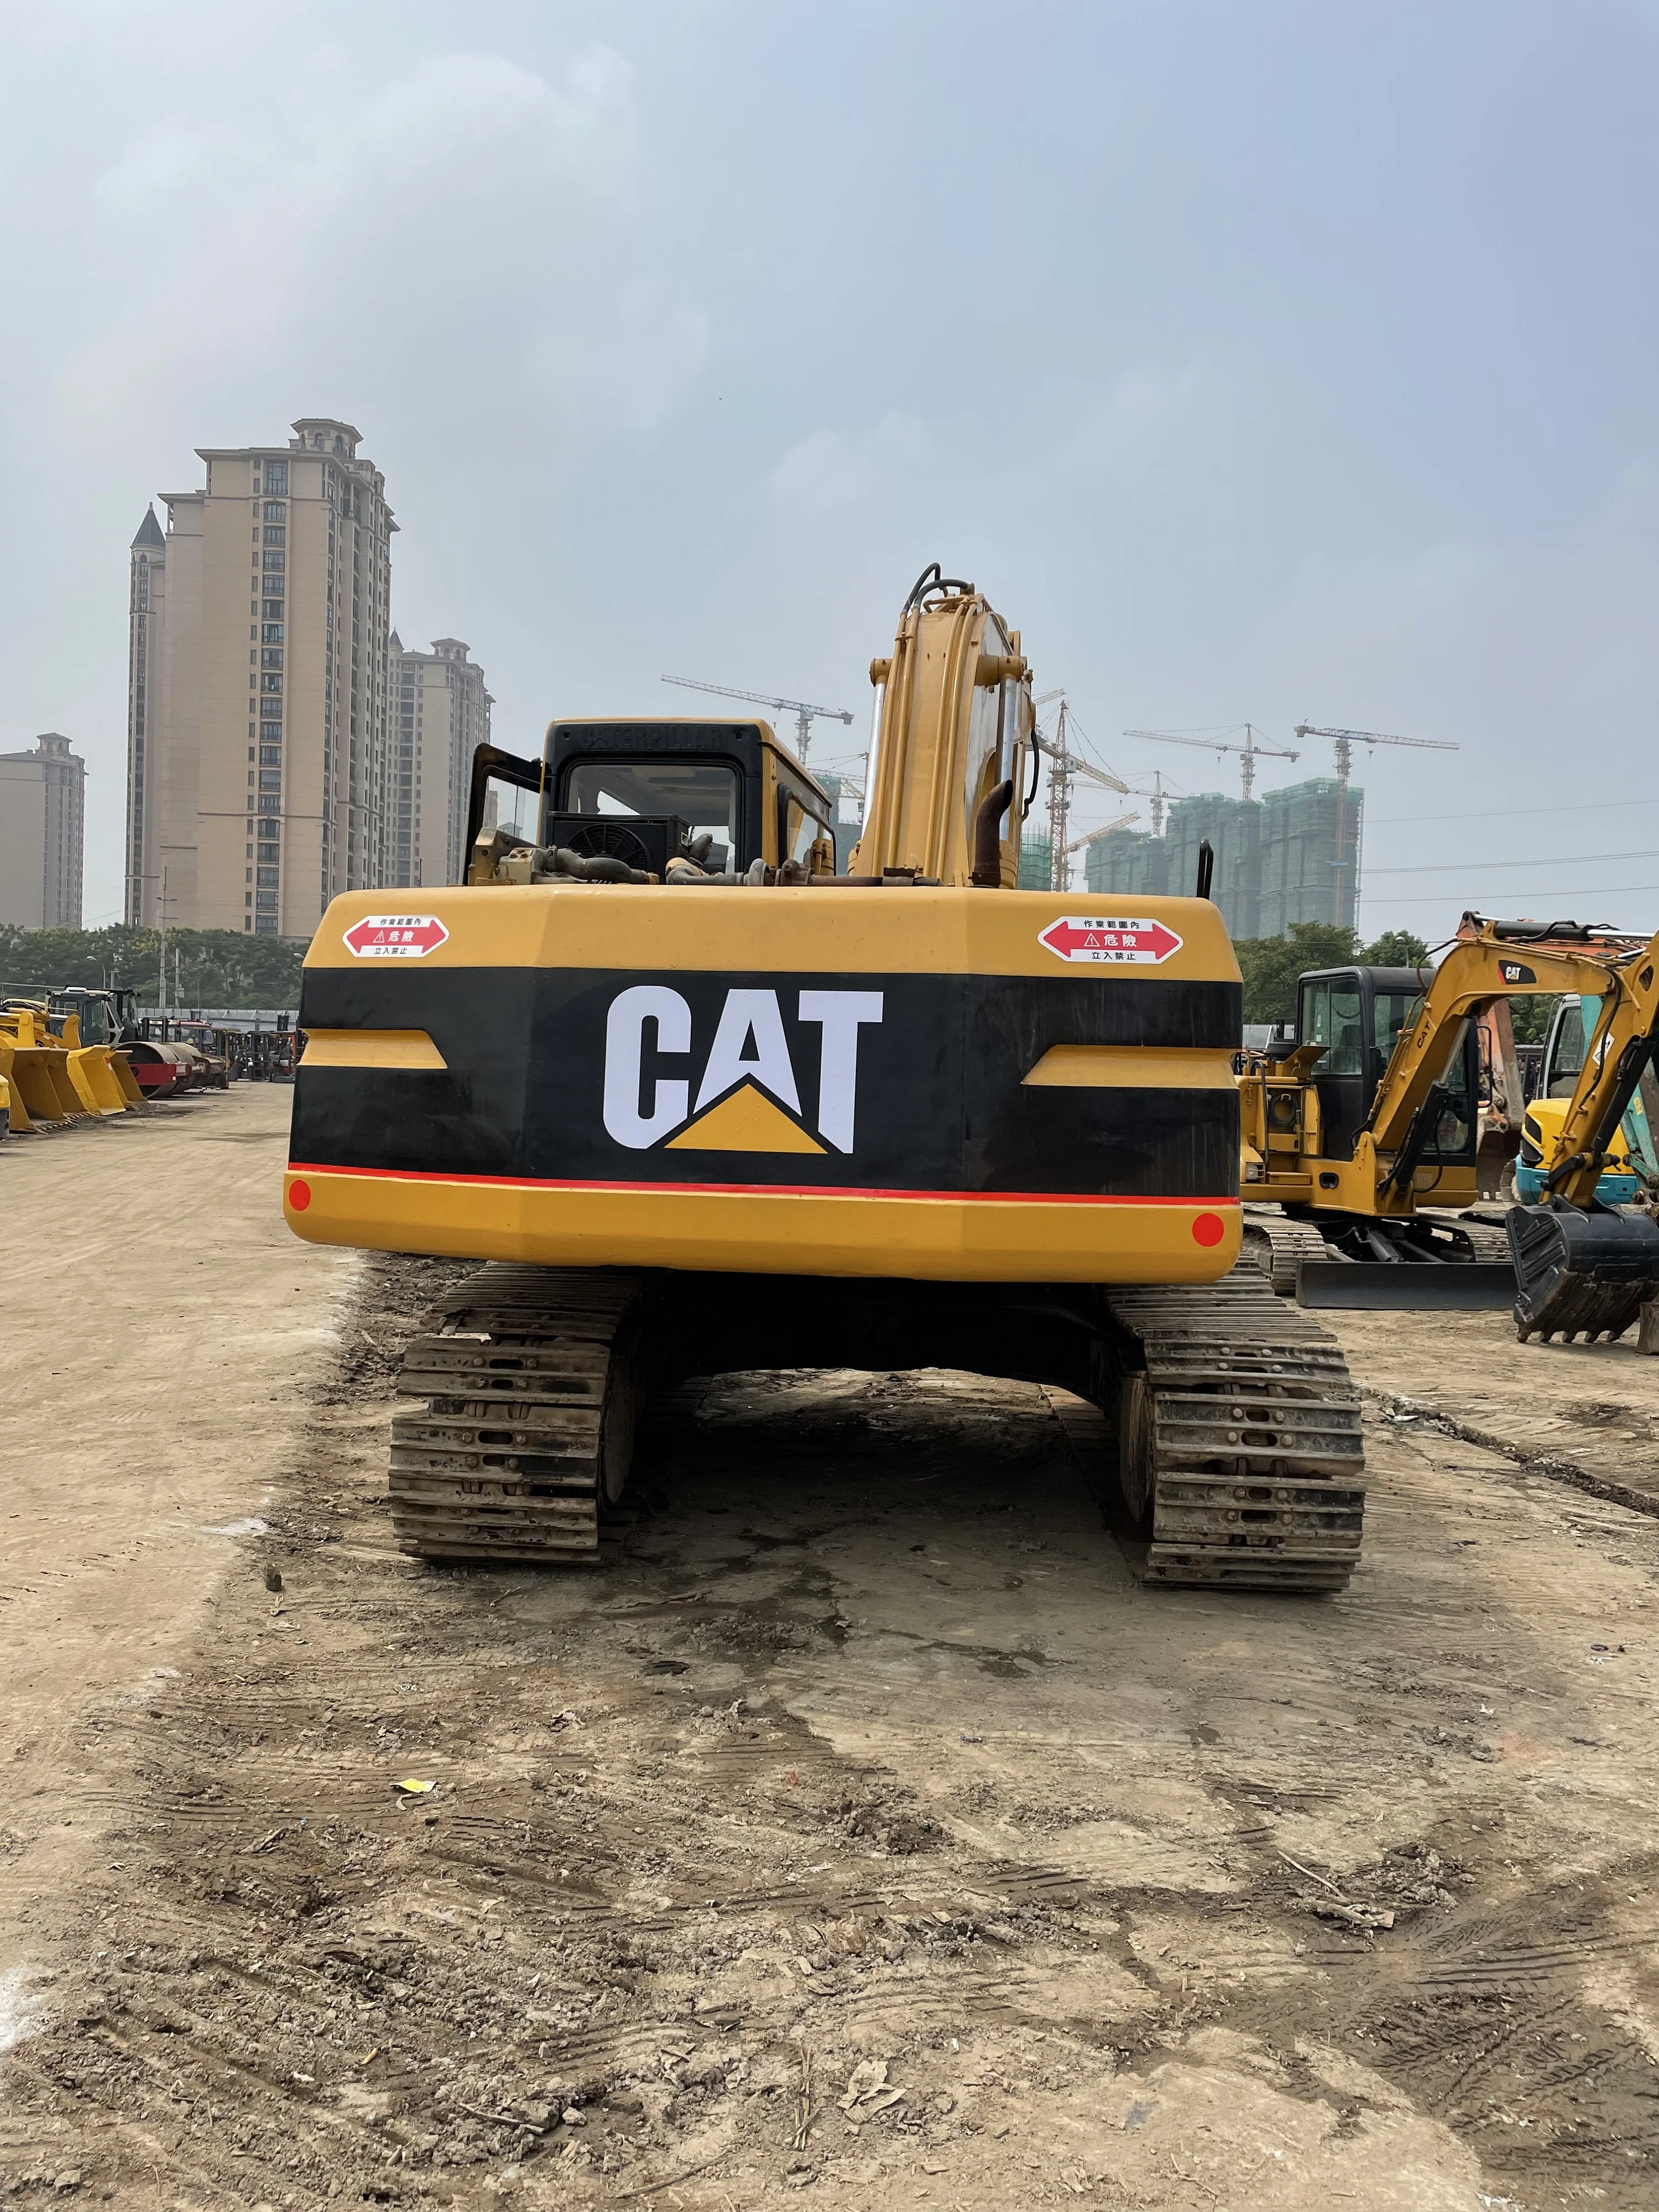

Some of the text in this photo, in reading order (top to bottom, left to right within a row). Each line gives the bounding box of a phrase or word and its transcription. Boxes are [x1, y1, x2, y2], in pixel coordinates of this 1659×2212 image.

[582, 726, 723, 750] CATERPILLAR
[388, 930, 414, 942] 危險
[1103, 934, 1137, 948] 危險
[1092, 951, 1136, 960] 立入禁止
[1506, 966, 1521, 980] CAT
[1417, 1021, 1430, 1048] CAT
[603, 985, 884, 1154] CAT
